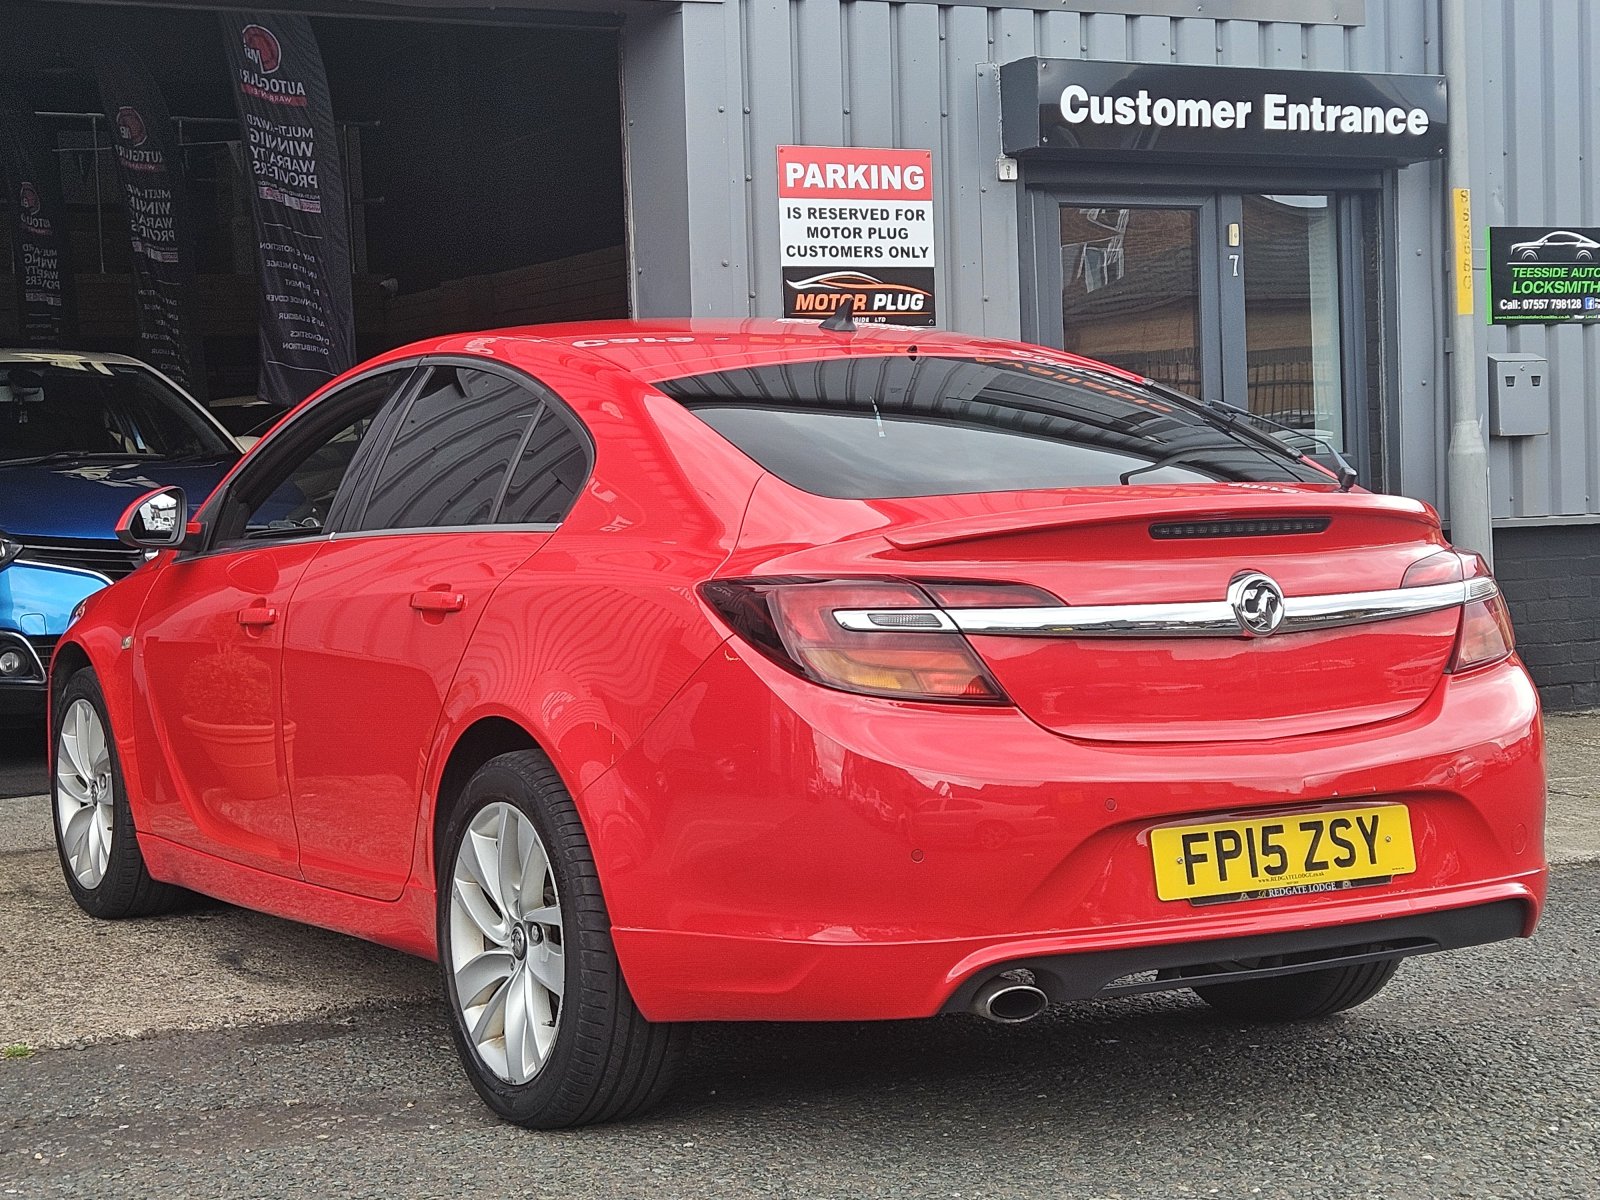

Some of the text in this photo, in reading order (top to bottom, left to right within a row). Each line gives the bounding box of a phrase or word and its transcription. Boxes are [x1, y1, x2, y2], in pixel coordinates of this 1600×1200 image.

[1060, 84, 1429, 135] Customer Entrance
[785, 162, 925, 191] PARKING
[787, 206, 926, 221] IS RESERVED FOR
[806, 226, 909, 240] MOTOR PLUG
[786, 245, 929, 259] CUSTOMERS ONLY
[1228, 254, 1239, 277] 7
[1512, 267, 1569, 278] TEESSIDE
[1512, 280, 1600, 294] LOCKSMITH
[873, 293, 925, 311] PLUG
[1500, 299, 1521, 310] Call:
[1522, 299, 1548, 310] 07557
[1551, 299, 1582, 310] 798128
[1181, 814, 1380, 886] FP15 ZSY
[1268, 884, 1308, 897] REDGATE
[1308, 882, 1337, 893] LODGE
